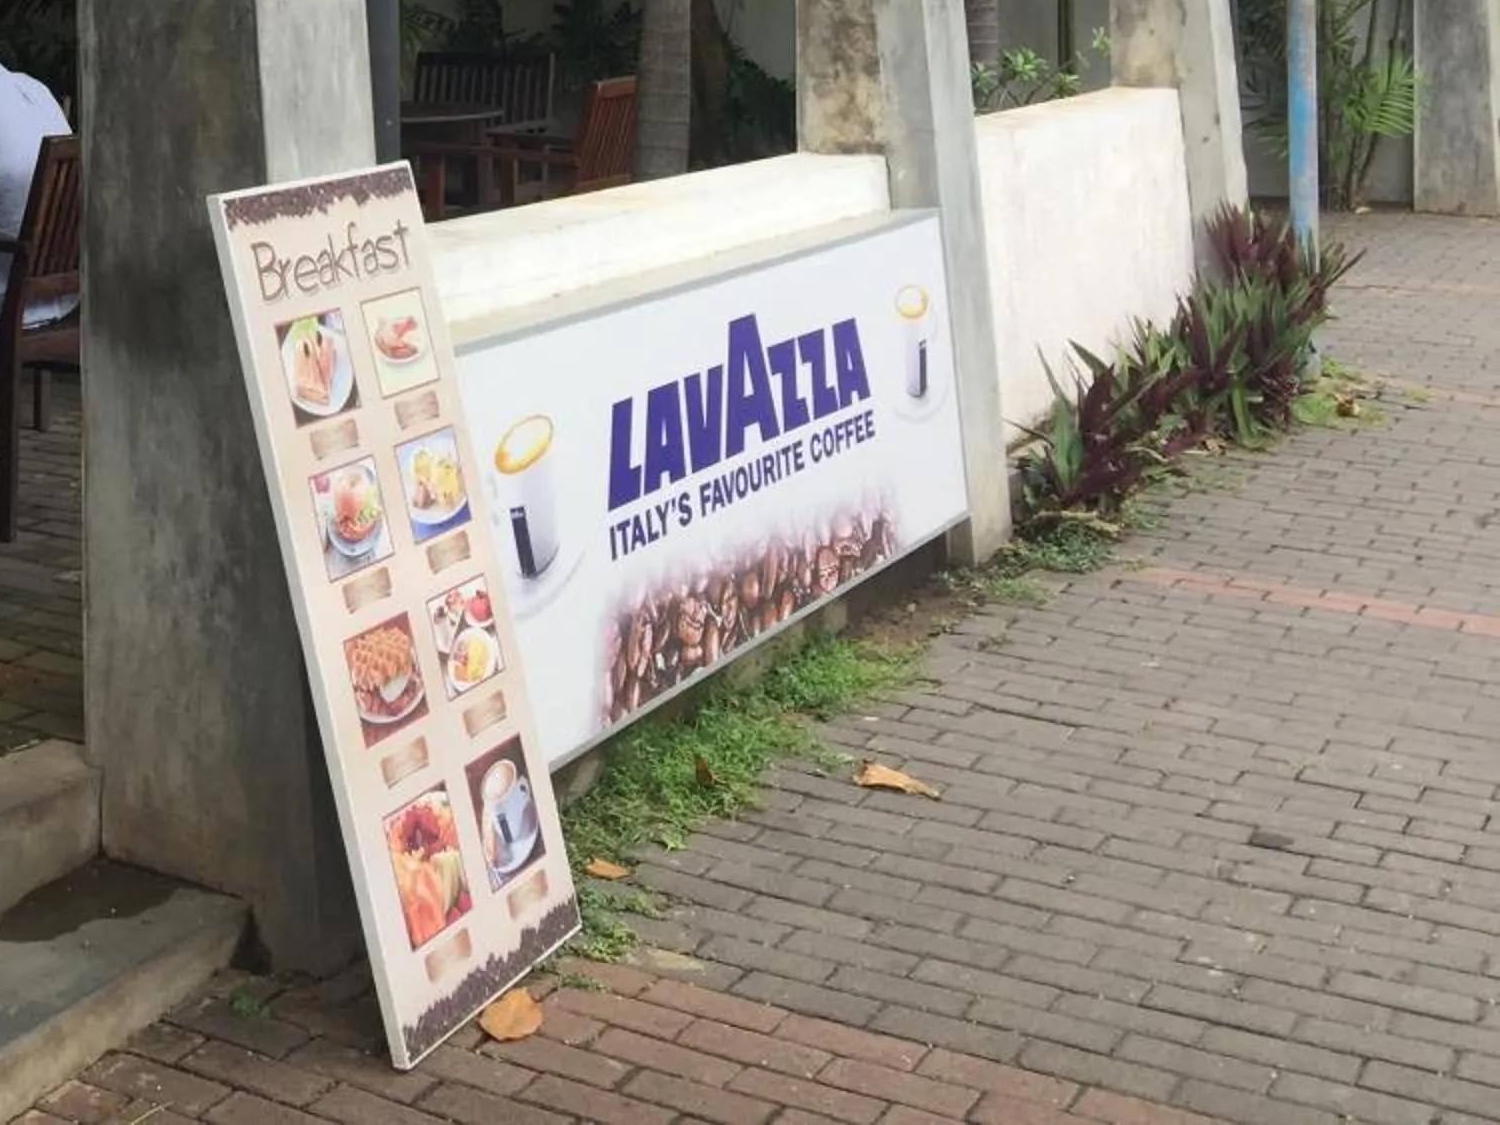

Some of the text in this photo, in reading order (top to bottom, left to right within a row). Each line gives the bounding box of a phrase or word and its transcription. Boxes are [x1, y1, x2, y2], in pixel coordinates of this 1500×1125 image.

[251, 218, 409, 302] Breakfast
[607, 313, 872, 512] LAVAZZA
[610, 409, 876, 561] ITALY'S FAVOURITE COFFEE
